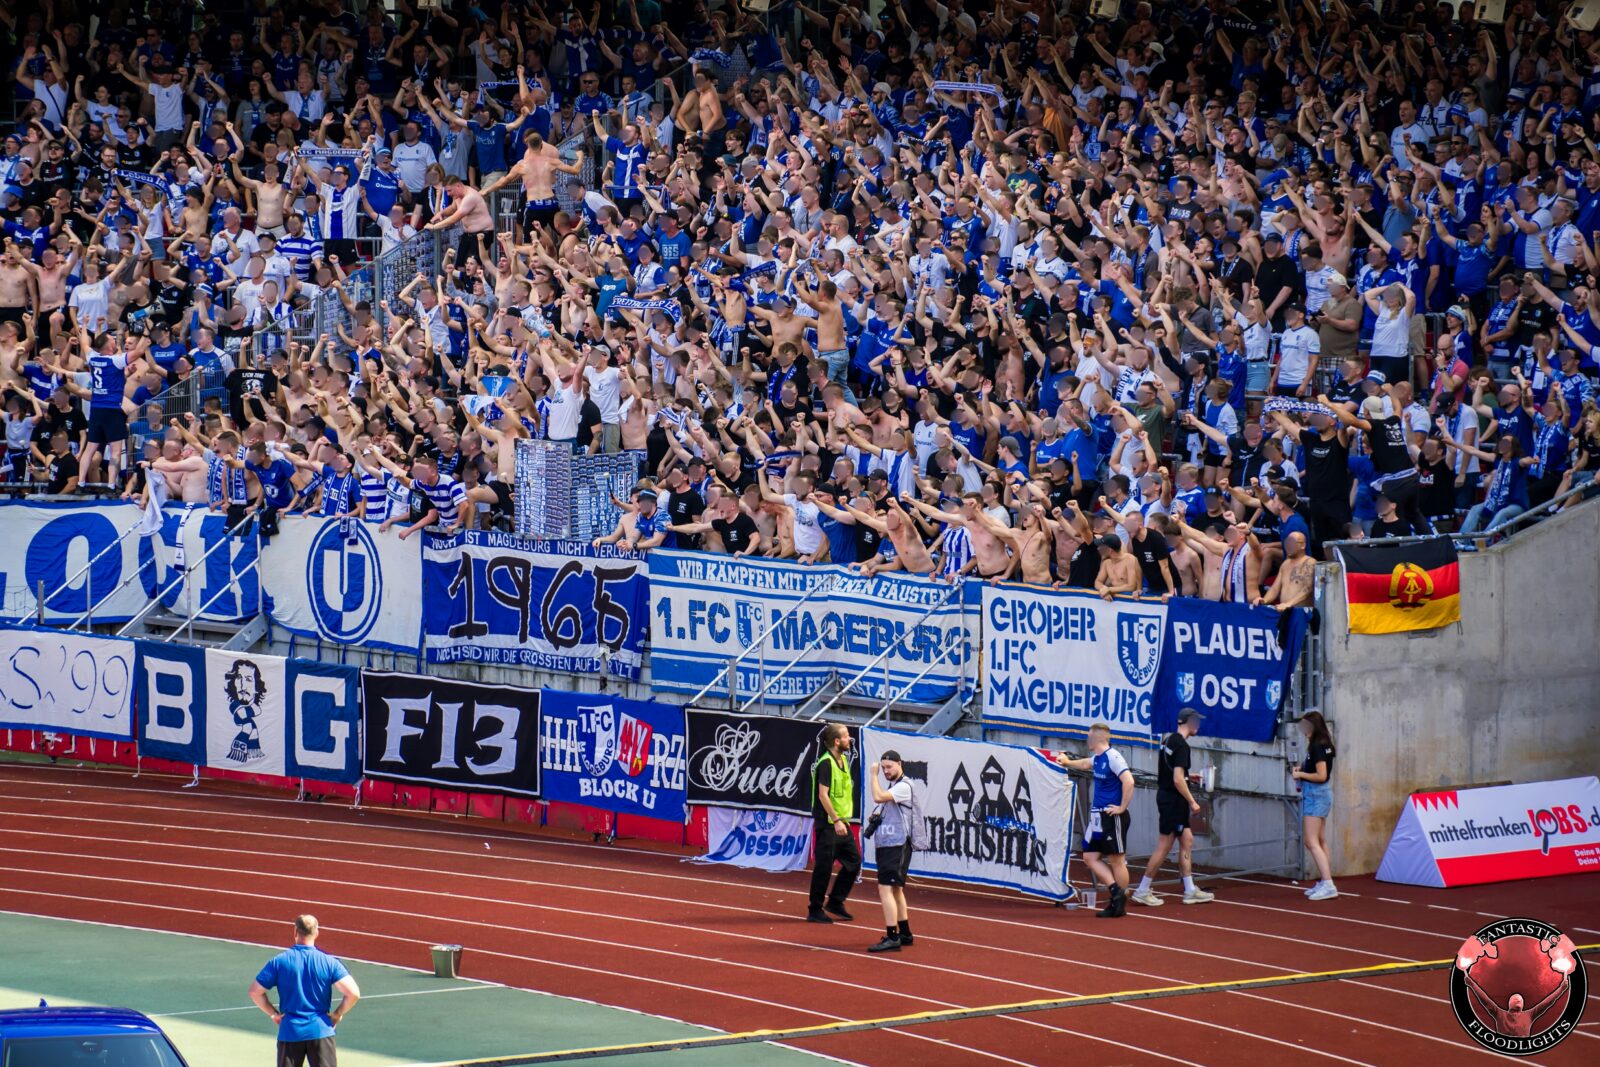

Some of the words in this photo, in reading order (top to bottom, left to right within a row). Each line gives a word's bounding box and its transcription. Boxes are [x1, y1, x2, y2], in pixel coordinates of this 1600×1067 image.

[465, 529, 481, 545] IST
[487, 533, 551, 553] MAGDEBURG
[556, 541, 588, 557] NICHT
[593, 544, 648, 559] VERLOREN
[448, 551, 637, 652] 1965
[677, 559, 705, 579] WIR
[706, 561, 775, 590] KÄMPFEN
[777, 571, 803, 590] MIT
[878, 579, 950, 606] FÄUSTEN
[656, 597, 730, 643] 1.FC
[1121, 620, 1158, 645] 1.FC
[990, 637, 1037, 675] 1.FC
[1173, 620, 1283, 662] PLAUEN
[436, 648, 461, 661] NOCH
[484, 647, 500, 662] WIR
[503, 649, 517, 663] DIE
[574, 657, 592, 671] AUF
[593, 658, 614, 675] DR
[1121, 645, 1157, 681] MAGDEBURG
[144, 655, 194, 745] B
[718, 669, 745, 690] FR
[749, 674, 804, 695] UNSERE
[989, 673, 1151, 726] MAGDEBURG
[1200, 673, 1257, 711] OST
[579, 777, 640, 805] BLOCK
[642, 788, 657, 810] U
